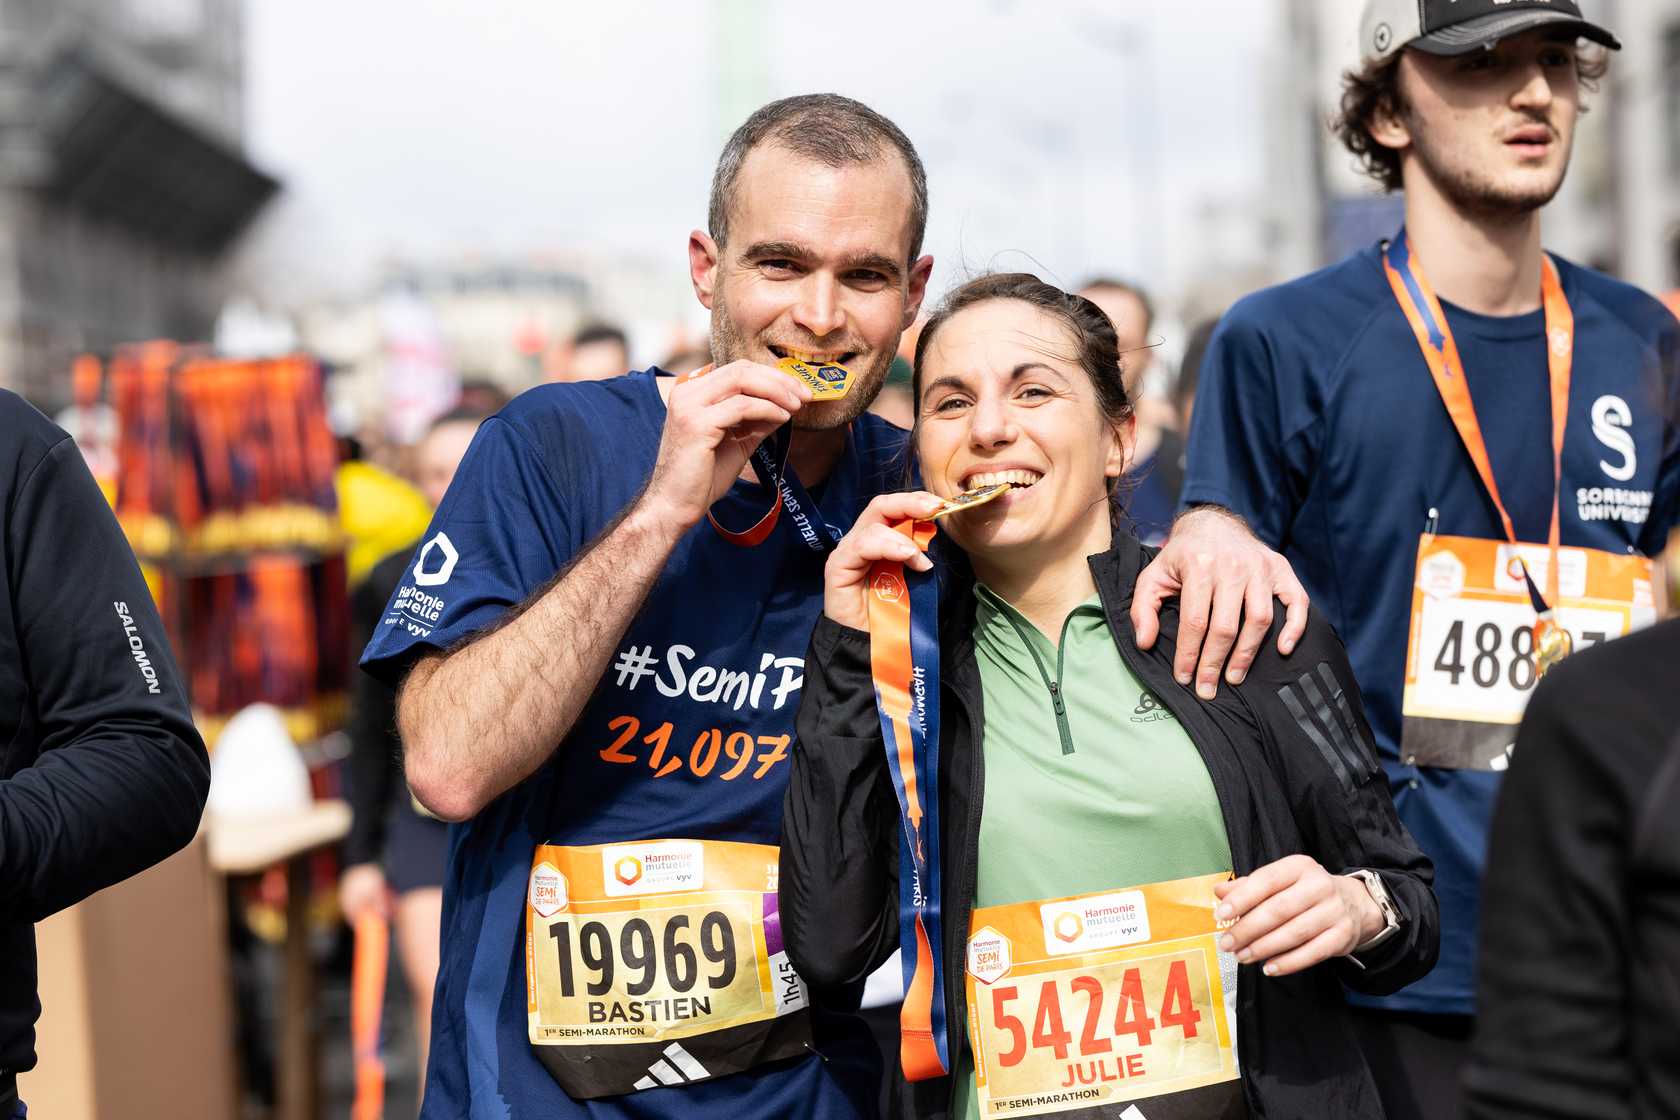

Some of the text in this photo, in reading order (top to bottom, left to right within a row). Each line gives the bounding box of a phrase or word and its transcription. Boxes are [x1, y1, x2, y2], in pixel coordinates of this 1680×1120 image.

[113, 601, 161, 694] SALOMON
[600, 715, 791, 781] 21,097
[645, 853, 692, 863] Harmonie
[676, 873, 692, 882] vyv
[1085, 903, 1136, 918] Harmonie
[1087, 911, 1137, 927] mutuelle
[1121, 926, 1139, 936] vyv
[549, 910, 737, 997] 19969
[778, 961, 801, 1006] 1h45
[588, 996, 712, 1024] BASTIEN
[991, 959, 1201, 1068] 54244
[559, 1026, 646, 1038] SEMI-MARATHON
[1061, 1053, 1147, 1088] JULIE
[1009, 1088, 1100, 1109] SEMI-MARATHON
